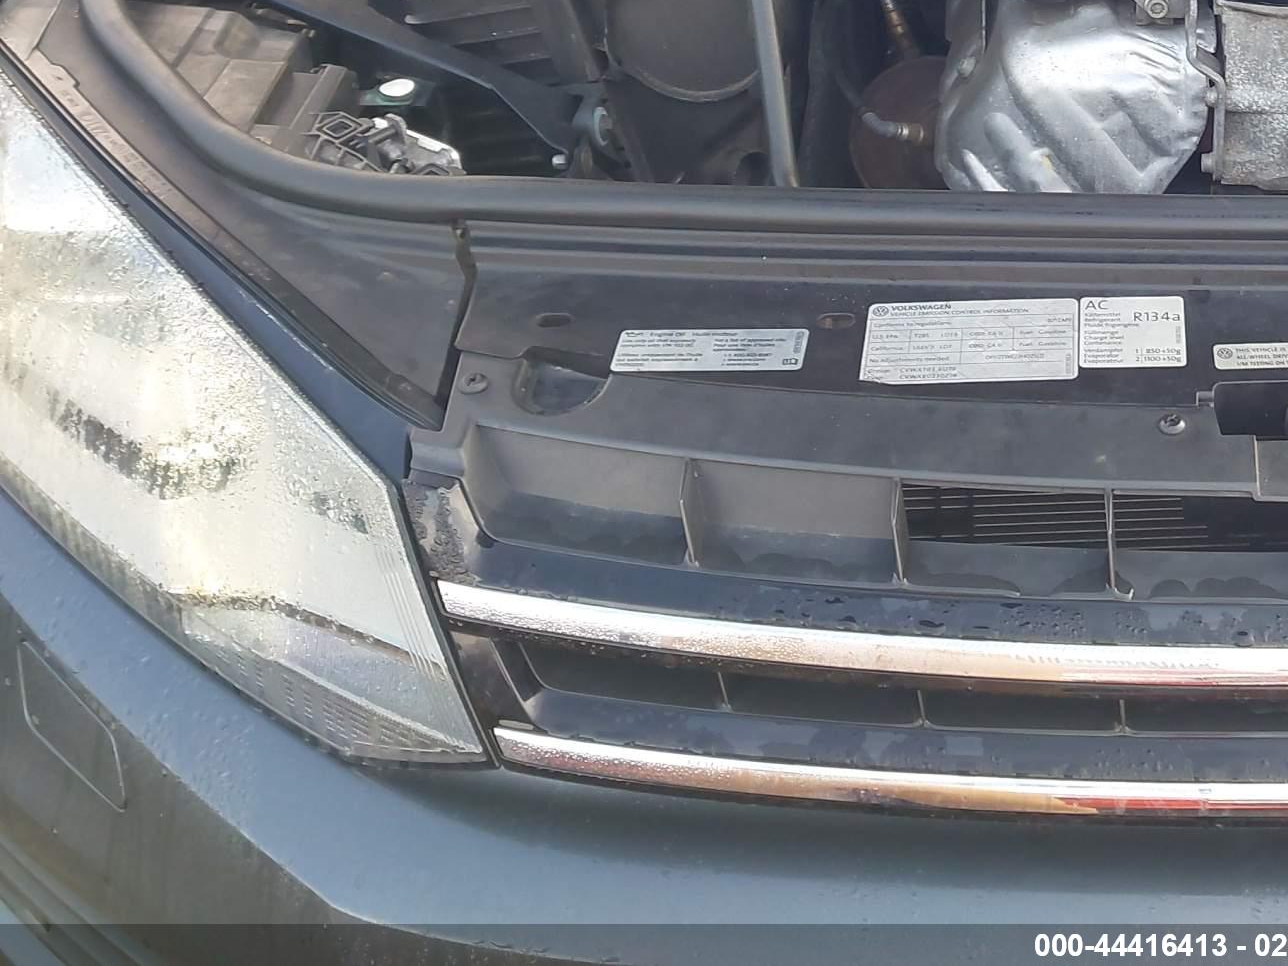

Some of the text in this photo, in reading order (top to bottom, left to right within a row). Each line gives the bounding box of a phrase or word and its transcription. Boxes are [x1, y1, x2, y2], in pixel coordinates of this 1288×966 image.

[891, 303, 952, 312] VOLKSWAGEN
[1084, 300, 1110, 310] AC
[1133, 311, 1181, 322] R134a
